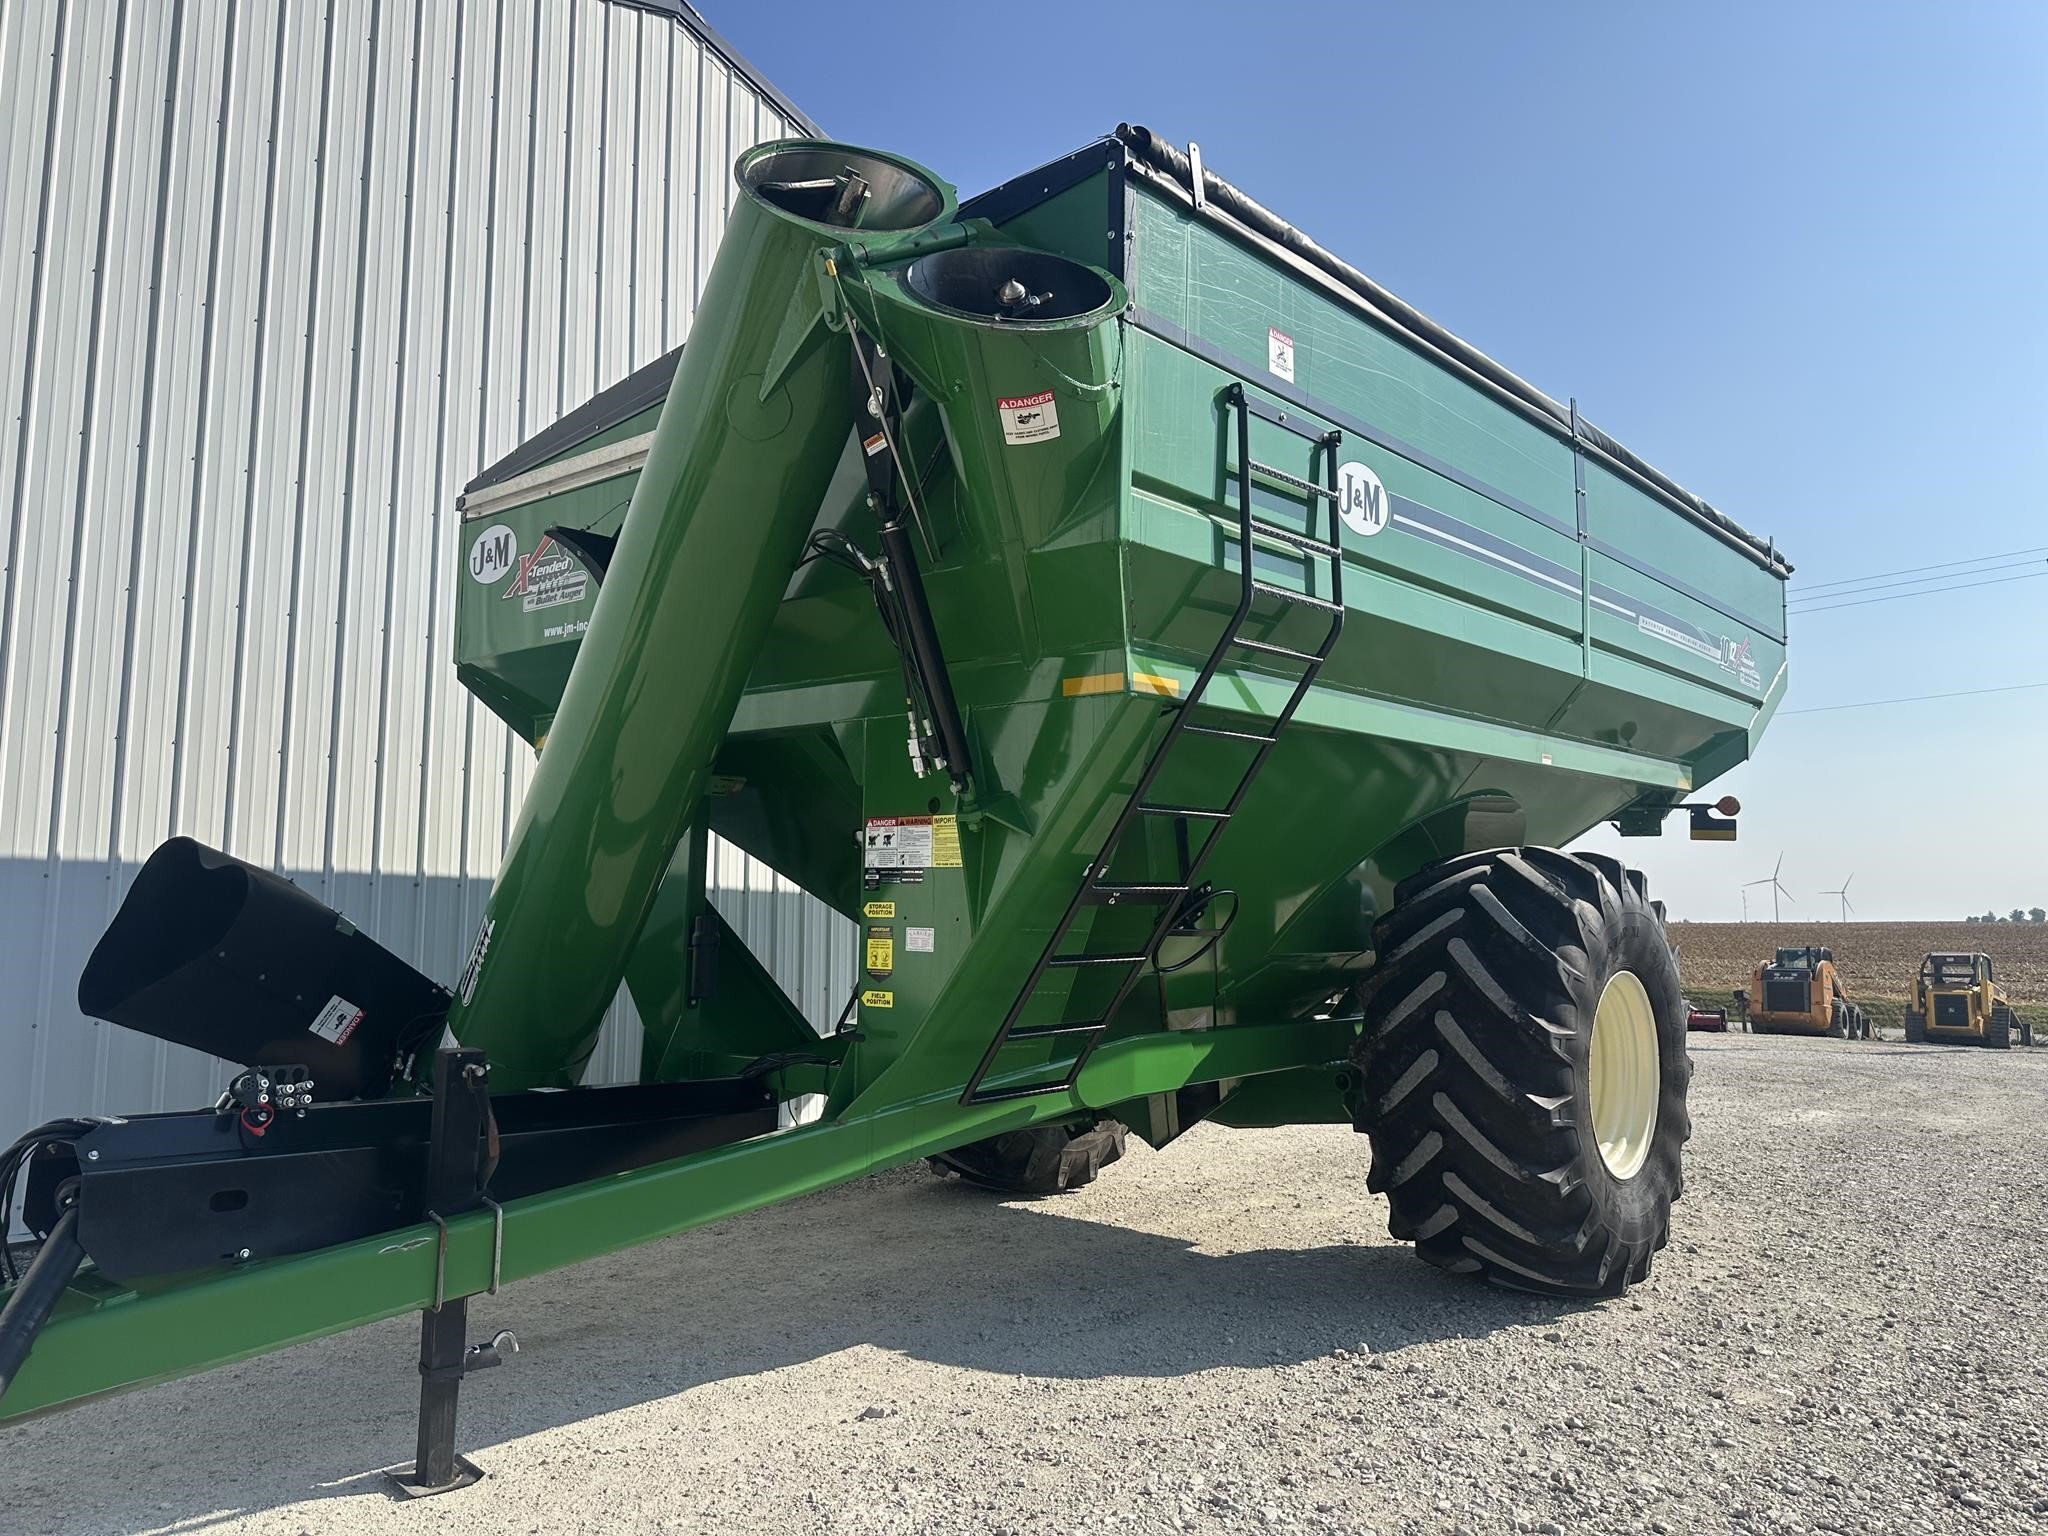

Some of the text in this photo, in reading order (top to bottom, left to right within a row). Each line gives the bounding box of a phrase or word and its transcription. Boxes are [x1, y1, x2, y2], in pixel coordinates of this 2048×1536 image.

[1009, 393, 1053, 408] DANGER
[1339, 473, 1381, 526] J&M
[472, 532, 512, 576] J&M
[535, 593, 558, 606] Bullet
[559, 588, 583, 601] Auger
[872, 819, 896, 827] DANGER
[866, 997, 891, 1006] POSITION
[336, 1016, 360, 1045] DANGER
